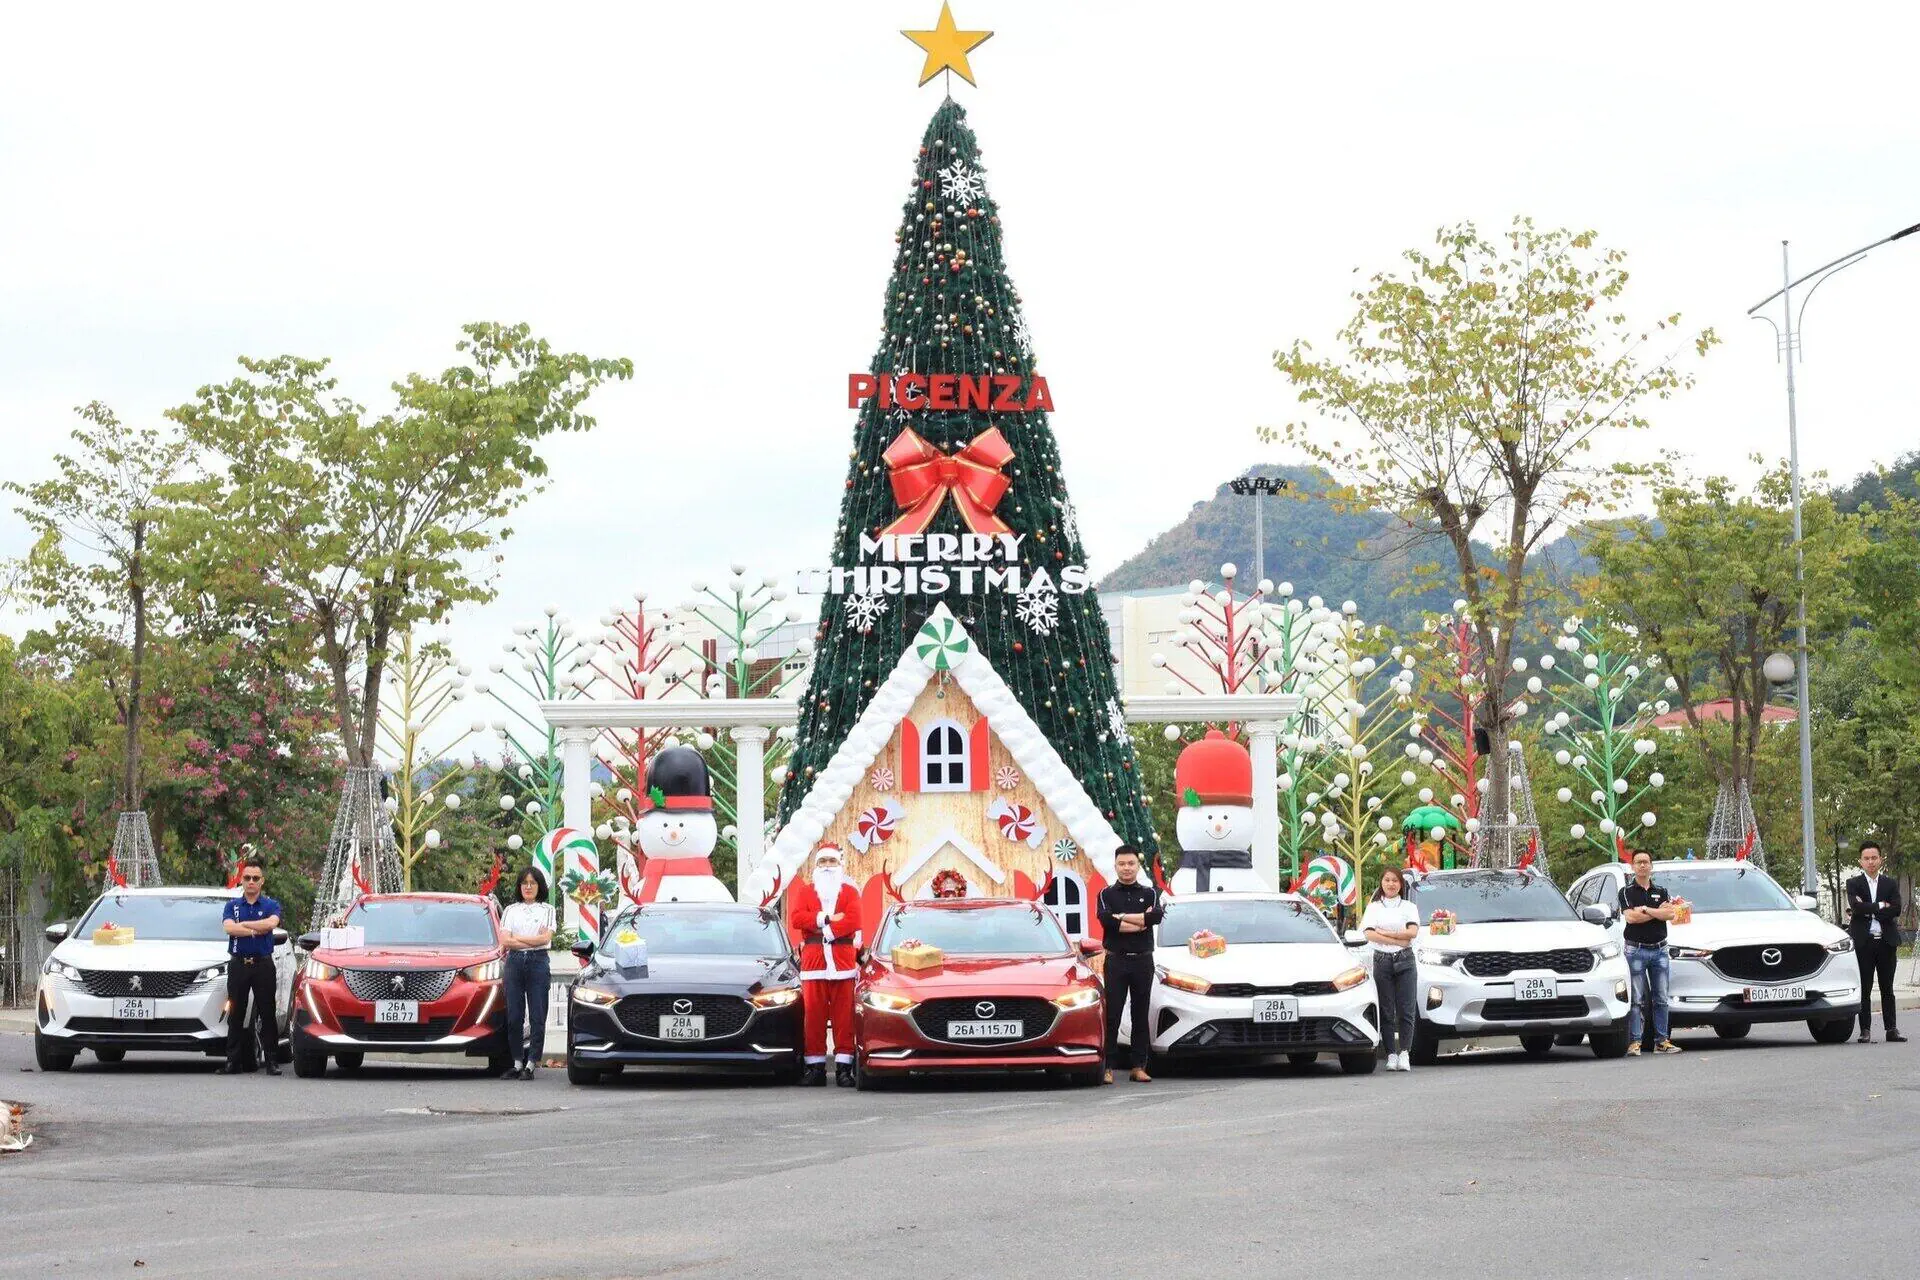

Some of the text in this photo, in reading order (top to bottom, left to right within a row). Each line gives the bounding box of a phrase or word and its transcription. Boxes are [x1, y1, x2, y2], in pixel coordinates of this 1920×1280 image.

[848, 373, 1054, 412] PICENZA
[859, 533, 1027, 562] MERRY
[1526, 979, 1544, 989] 28A
[1521, 989, 1552, 999] 185.39
[125, 999, 142, 1008] 26A
[387, 1002, 406, 1011] 26A
[1266, 1000, 1285, 1010] 28A
[119, 1009, 149, 1018] 156.81
[1260, 1010, 1293, 1021] 185.07
[672, 1017, 692, 1027] 28A
[665, 1028, 700, 1038] 164.30
[954, 1024, 1017, 1035] 26A-115.70
